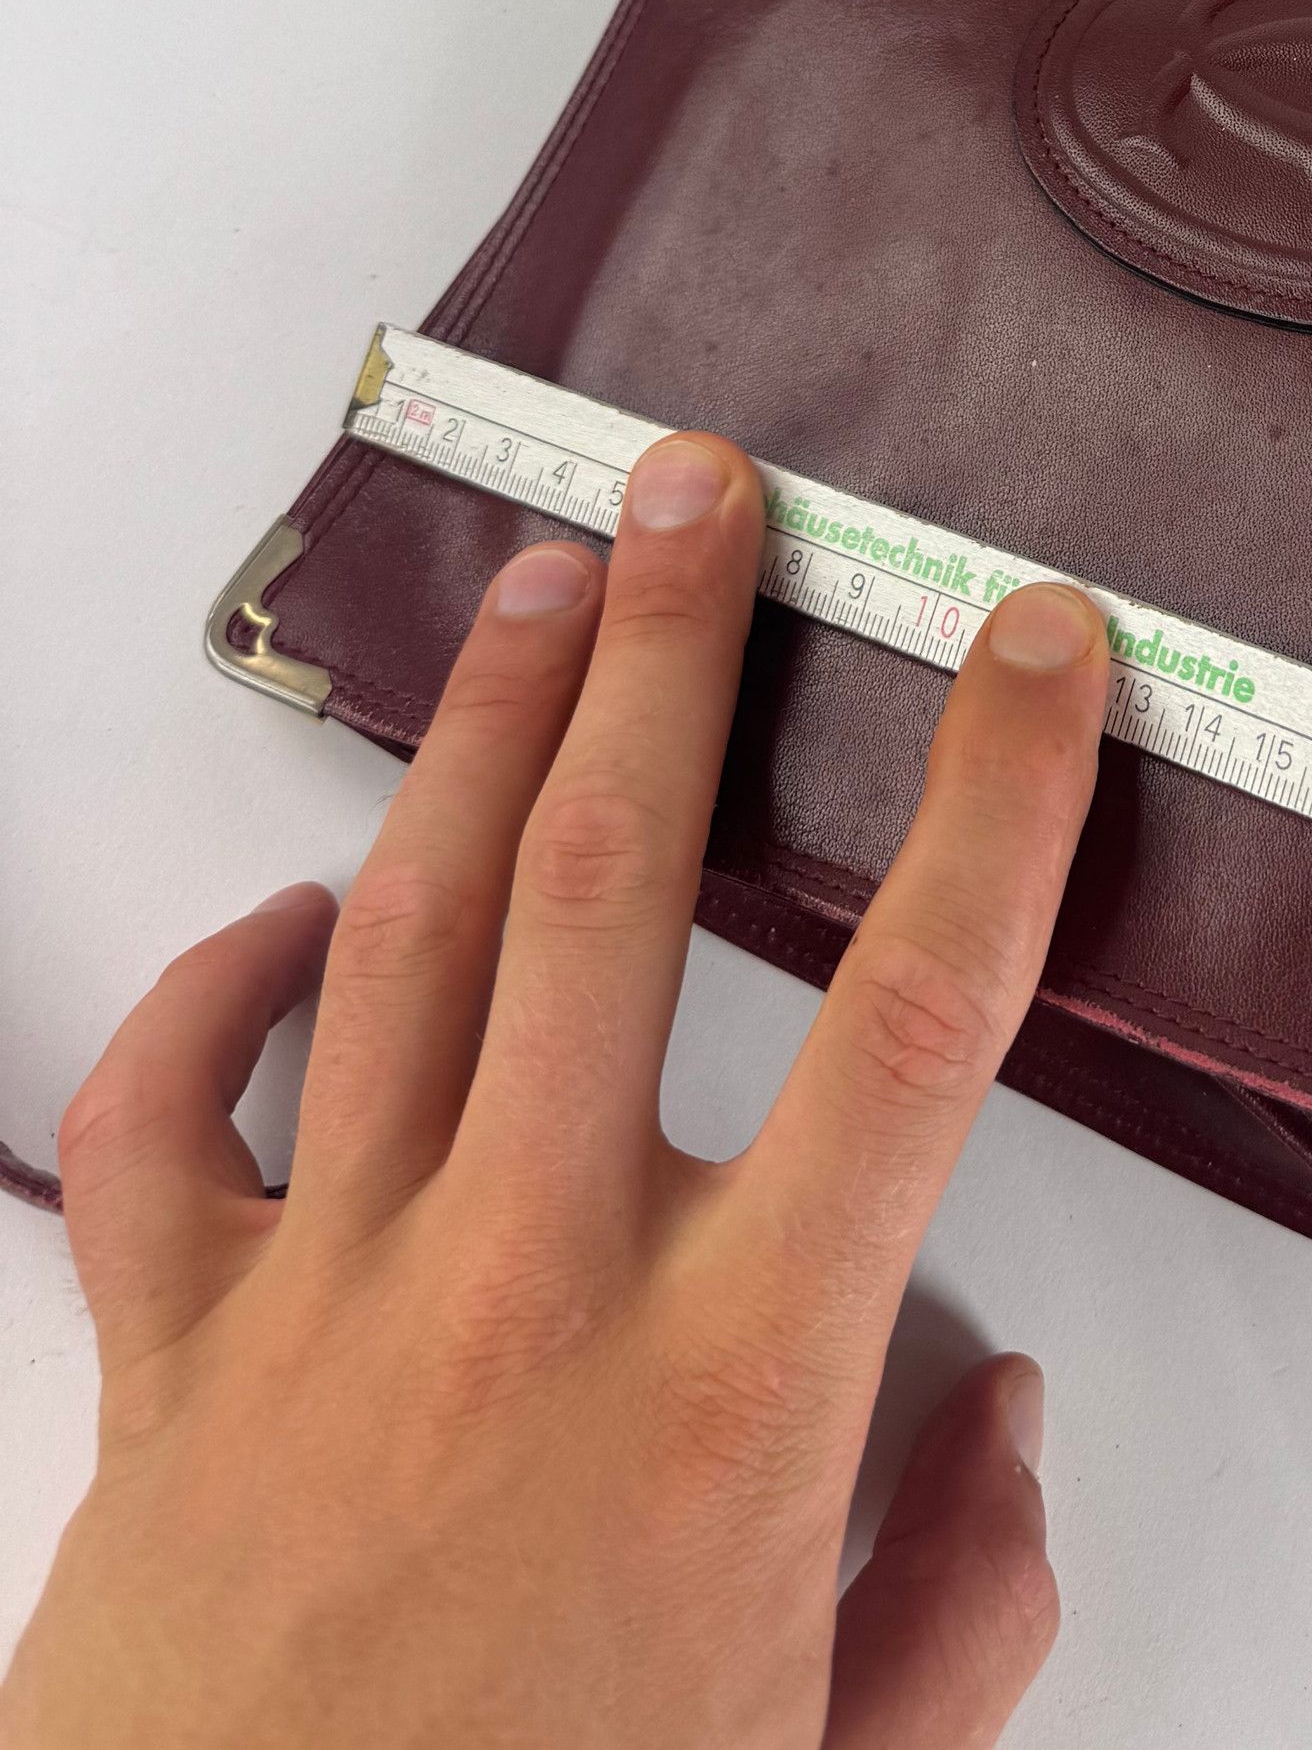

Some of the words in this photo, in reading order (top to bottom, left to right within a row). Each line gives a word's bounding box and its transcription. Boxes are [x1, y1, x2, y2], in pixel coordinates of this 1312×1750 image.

[442, 417, 459, 443] 2
[496, 437, 513, 463] 3
[552, 460, 569, 485] 4
[608, 480, 626, 506] 5
[786, 549, 803, 575] 8
[848, 573, 866, 600] 9
[915, 595, 960, 639] 10
[1115, 676, 1153, 713] 13
[1185, 703, 1223, 743] 14
[1256, 732, 1294, 771] 15
[763, 486, 977, 596] häusetechnik
[1106, 615, 1256, 704] Industrie
